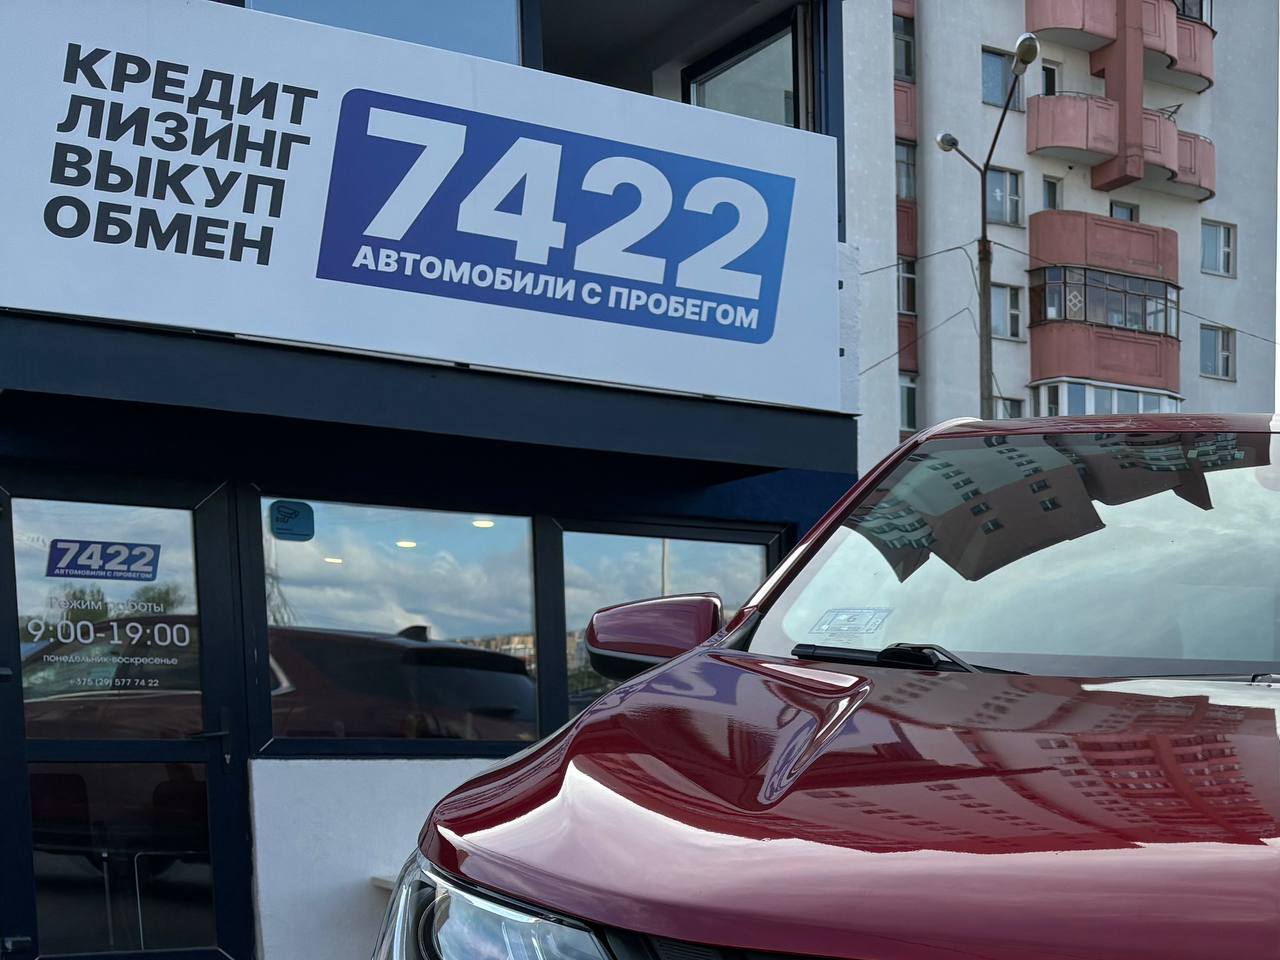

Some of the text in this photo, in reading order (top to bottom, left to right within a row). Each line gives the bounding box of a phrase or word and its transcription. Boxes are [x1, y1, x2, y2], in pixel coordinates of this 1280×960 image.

[62, 42, 318, 126] КРЕДИТ
[56, 94, 311, 171] ЛИЗИНГ
[50, 143, 286, 219] ВЫКУП
[364, 107, 769, 300] 7422
[43, 196, 274, 266] ОБМЕН
[352, 245, 760, 330] АВТОМОБИЛИ С ПРОБЕГОМ
[56, 542, 154, 573] 7422
[27, 619, 190, 647] 9:00-19:00
[114, 678, 132, 687] 577
[133, 678, 147, 687] 74
[147, 679, 159, 688] 22
